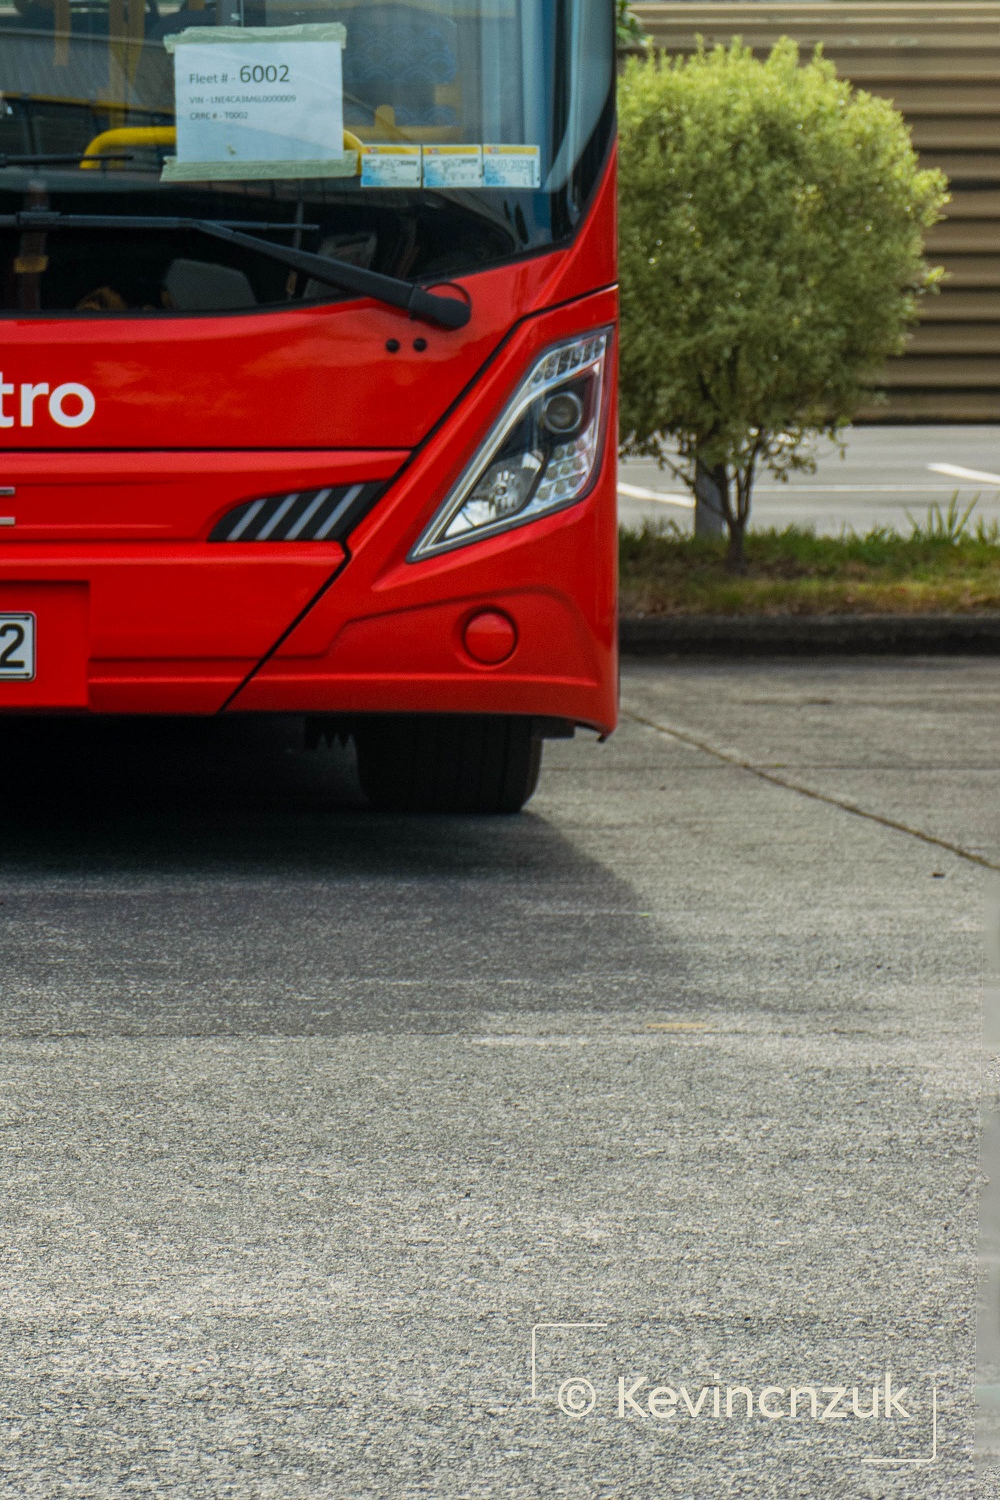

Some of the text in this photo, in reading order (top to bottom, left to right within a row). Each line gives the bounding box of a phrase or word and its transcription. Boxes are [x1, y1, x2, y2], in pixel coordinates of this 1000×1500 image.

[189, 73, 218, 83] Fleet
[221, 74, 228, 82] #
[240, 65, 290, 83] 6002
[189, 96, 204, 104] VIN
